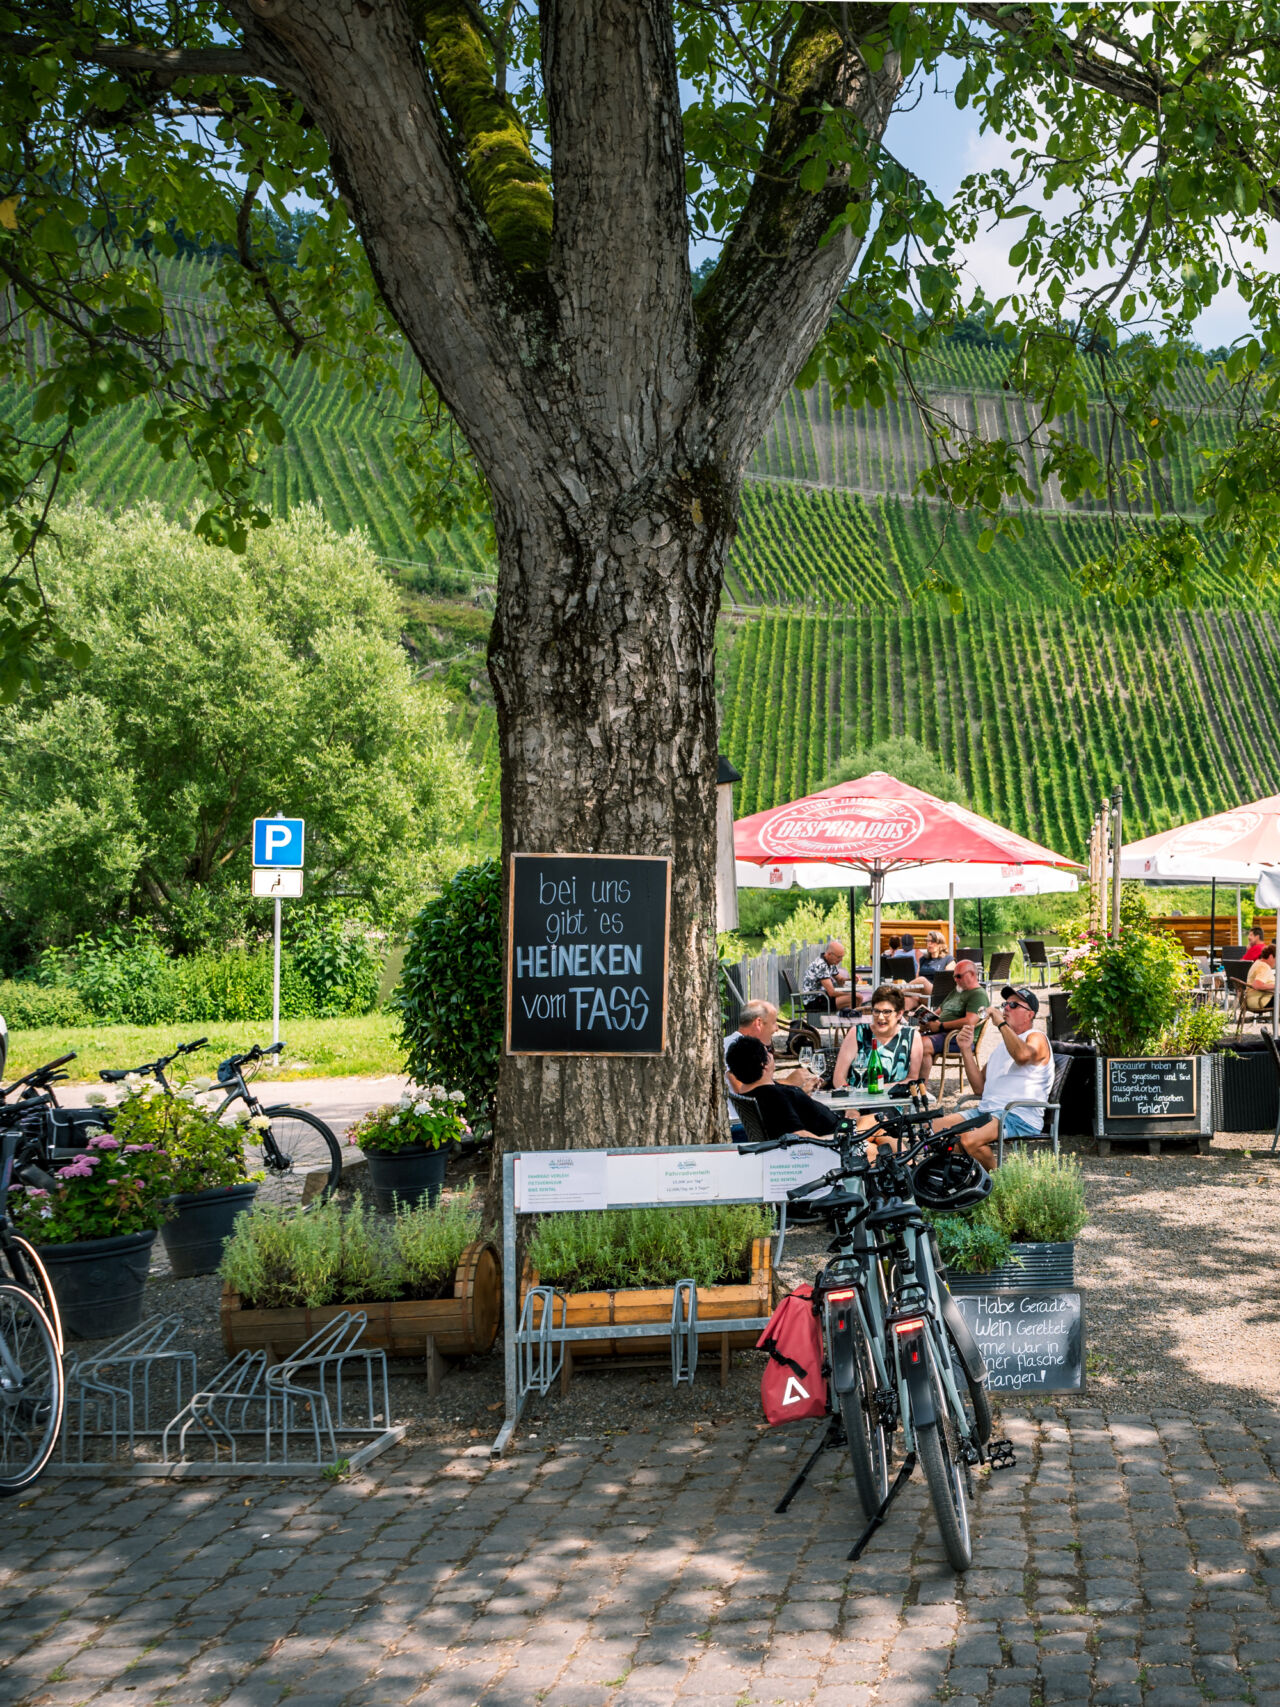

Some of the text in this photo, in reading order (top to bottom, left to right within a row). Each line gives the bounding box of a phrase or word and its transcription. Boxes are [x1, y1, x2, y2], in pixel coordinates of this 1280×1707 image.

[775, 819, 908, 839] DESPERADOS
[265, 825, 292, 860] P
[539, 872, 631, 905] bei uns
[546, 909, 624, 944] gibt es
[522, 986, 650, 1031] vom FASS
[1151, 1062, 1171, 1070] haben
[1131, 1073, 1160, 1085] gegessen
[1163, 1072, 1177, 1081] und
[1137, 1101, 1170, 1114] Fehler!
[978, 1296, 1015, 1314] Habe
[975, 1318, 1069, 1336] Wein Gerettet,
[979, 1342, 1006, 1356] rme
[1048, 1341, 1059, 1353] in
[983, 1354, 1011, 1369] iner
